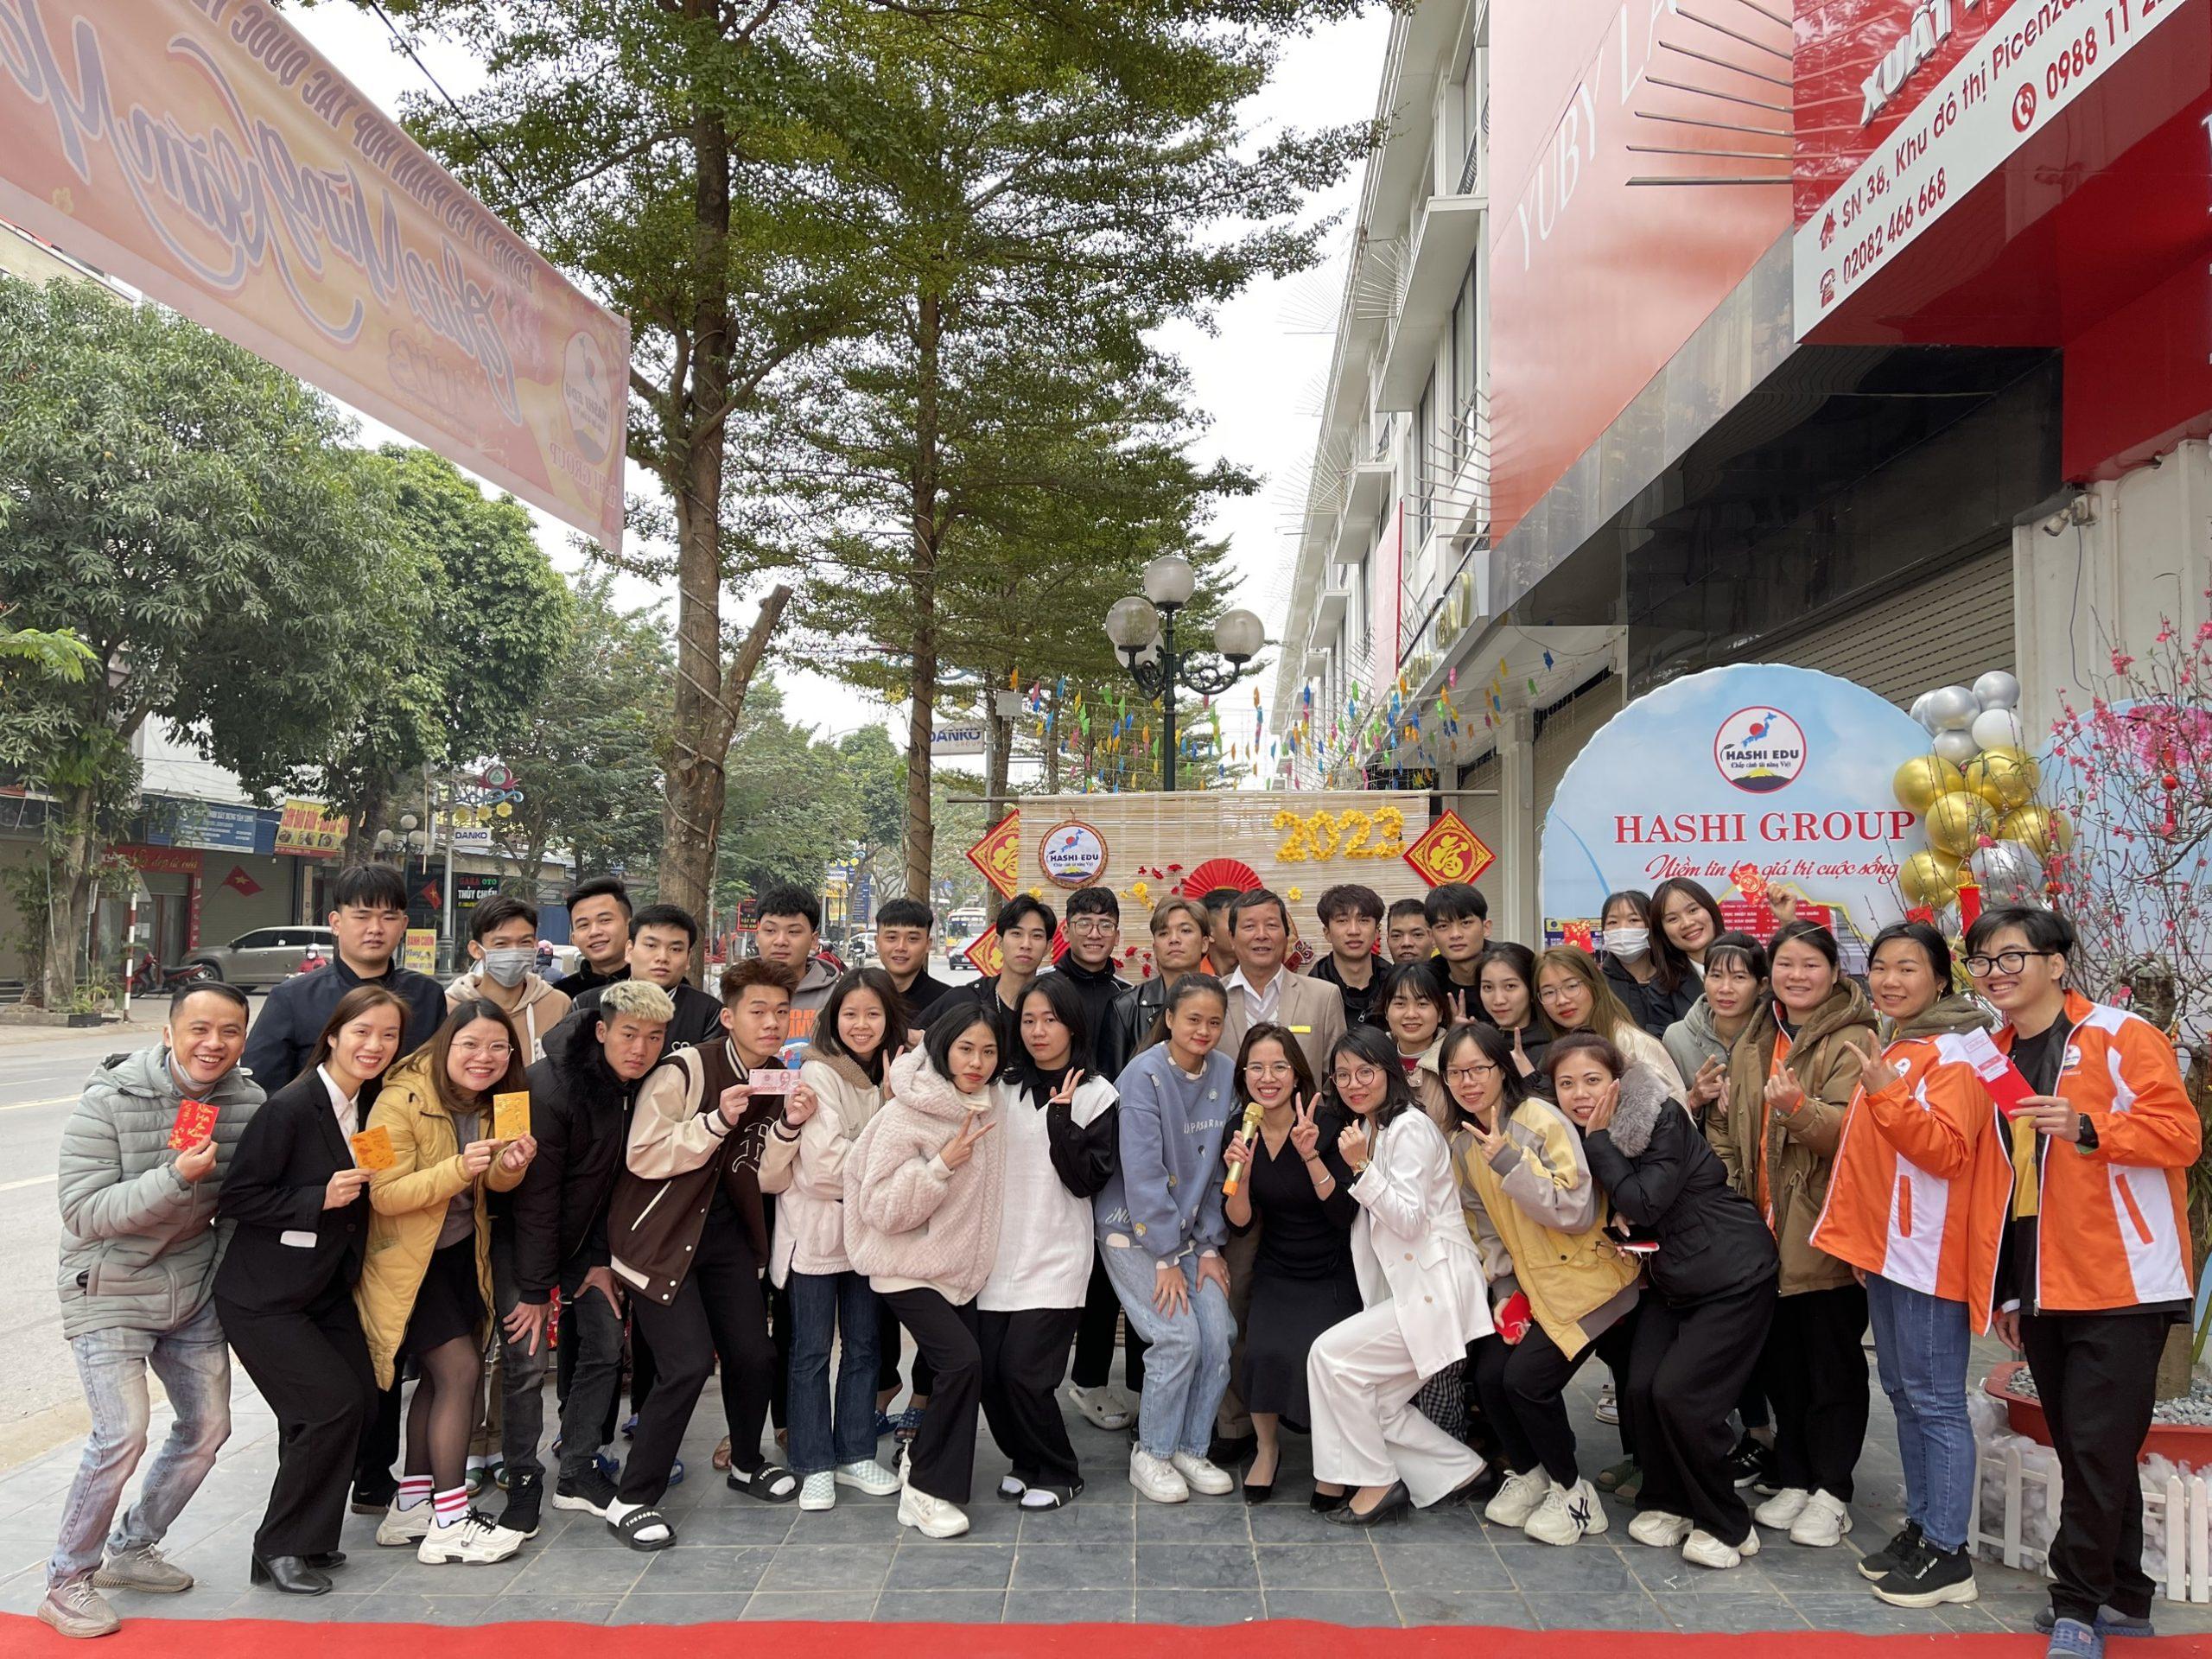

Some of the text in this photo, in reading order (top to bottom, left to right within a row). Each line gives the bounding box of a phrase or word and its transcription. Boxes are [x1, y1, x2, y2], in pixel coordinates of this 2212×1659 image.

[2045, 26, 2098, 101] 0988
[1516, 47, 1605, 272] YUBY
[1842, 193, 1863, 228] SN
[1895, 131, 1929, 180] Khu
[1933, 90, 1957, 139] đô
[1961, 60, 1987, 111] thị
[1842, 166, 1948, 285] 02082 466 668
[1726, 749, 1800, 761] HASHI EDU
[454, 831, 488, 840] DANKO
[1272, 805, 1407, 863] 2023
[1614, 810, 1916, 844] HASHI GROUP
[1050, 854, 1078, 862] HASHI
[1644, 853, 1701, 880] Niềm
[1703, 859, 1726, 877] tin
[1761, 858, 1788, 882] giá
[1792, 857, 1814, 879] trị
[1816, 859, 1856, 880] cuộc
[1857, 855, 1900, 885] sống
